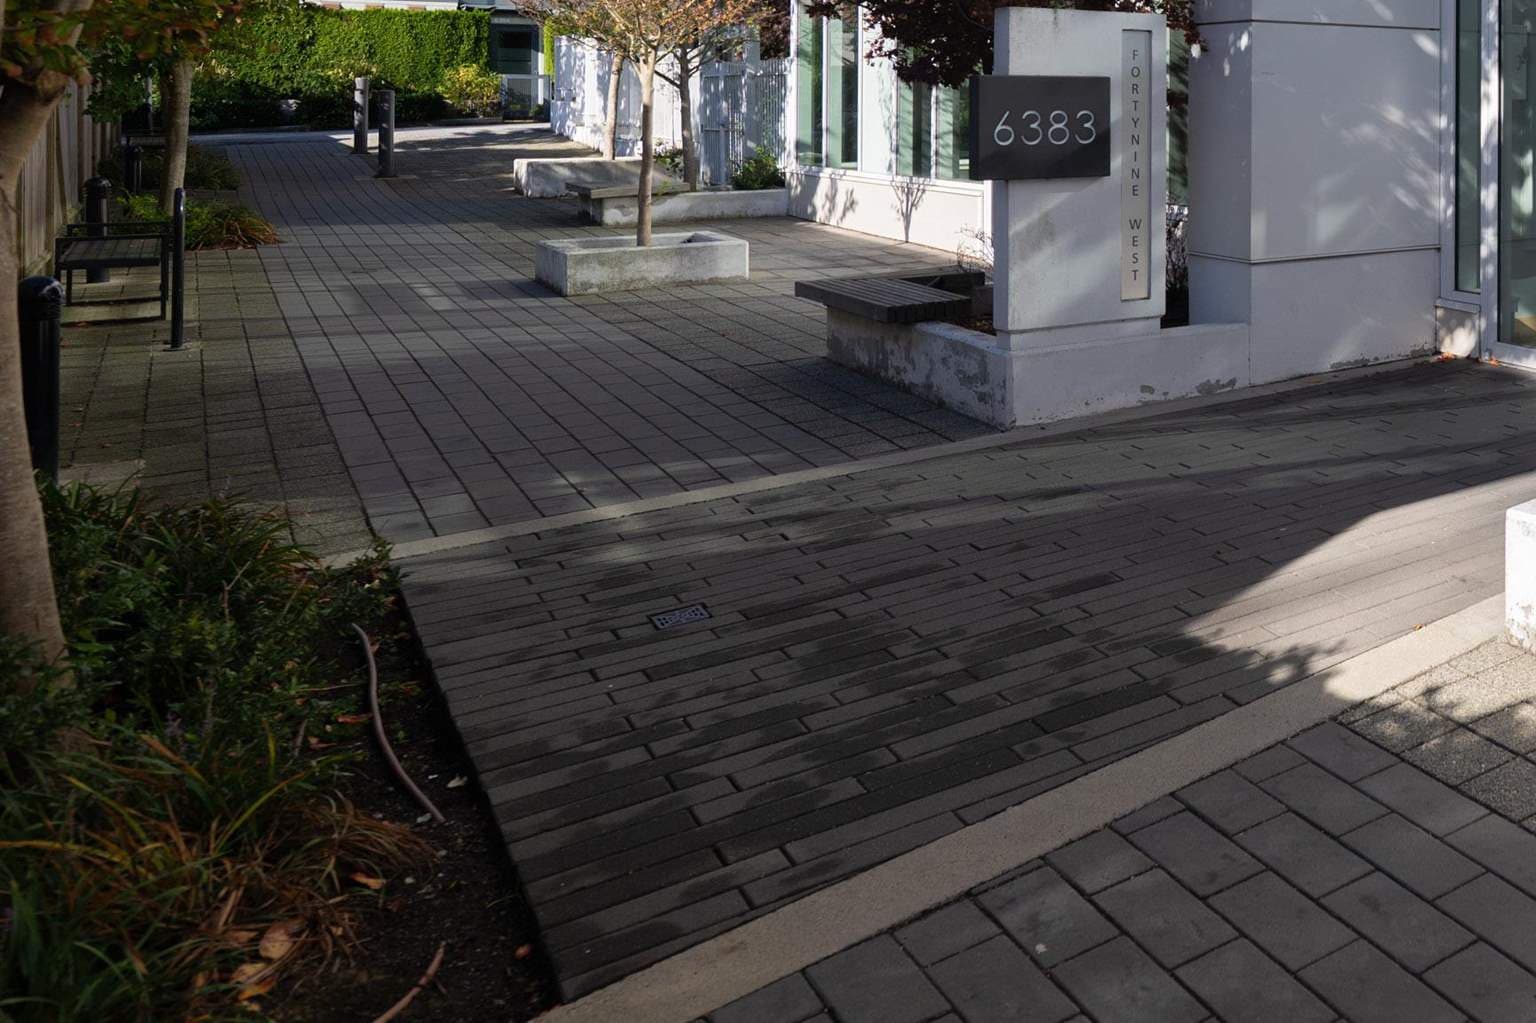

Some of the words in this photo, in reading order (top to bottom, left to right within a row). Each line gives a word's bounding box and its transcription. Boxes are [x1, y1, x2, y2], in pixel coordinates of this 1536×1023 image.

[993, 109, 1097, 146] 6383
[1130, 49, 1141, 197] FORTYNINE
[1128, 218, 1142, 281] WEST
